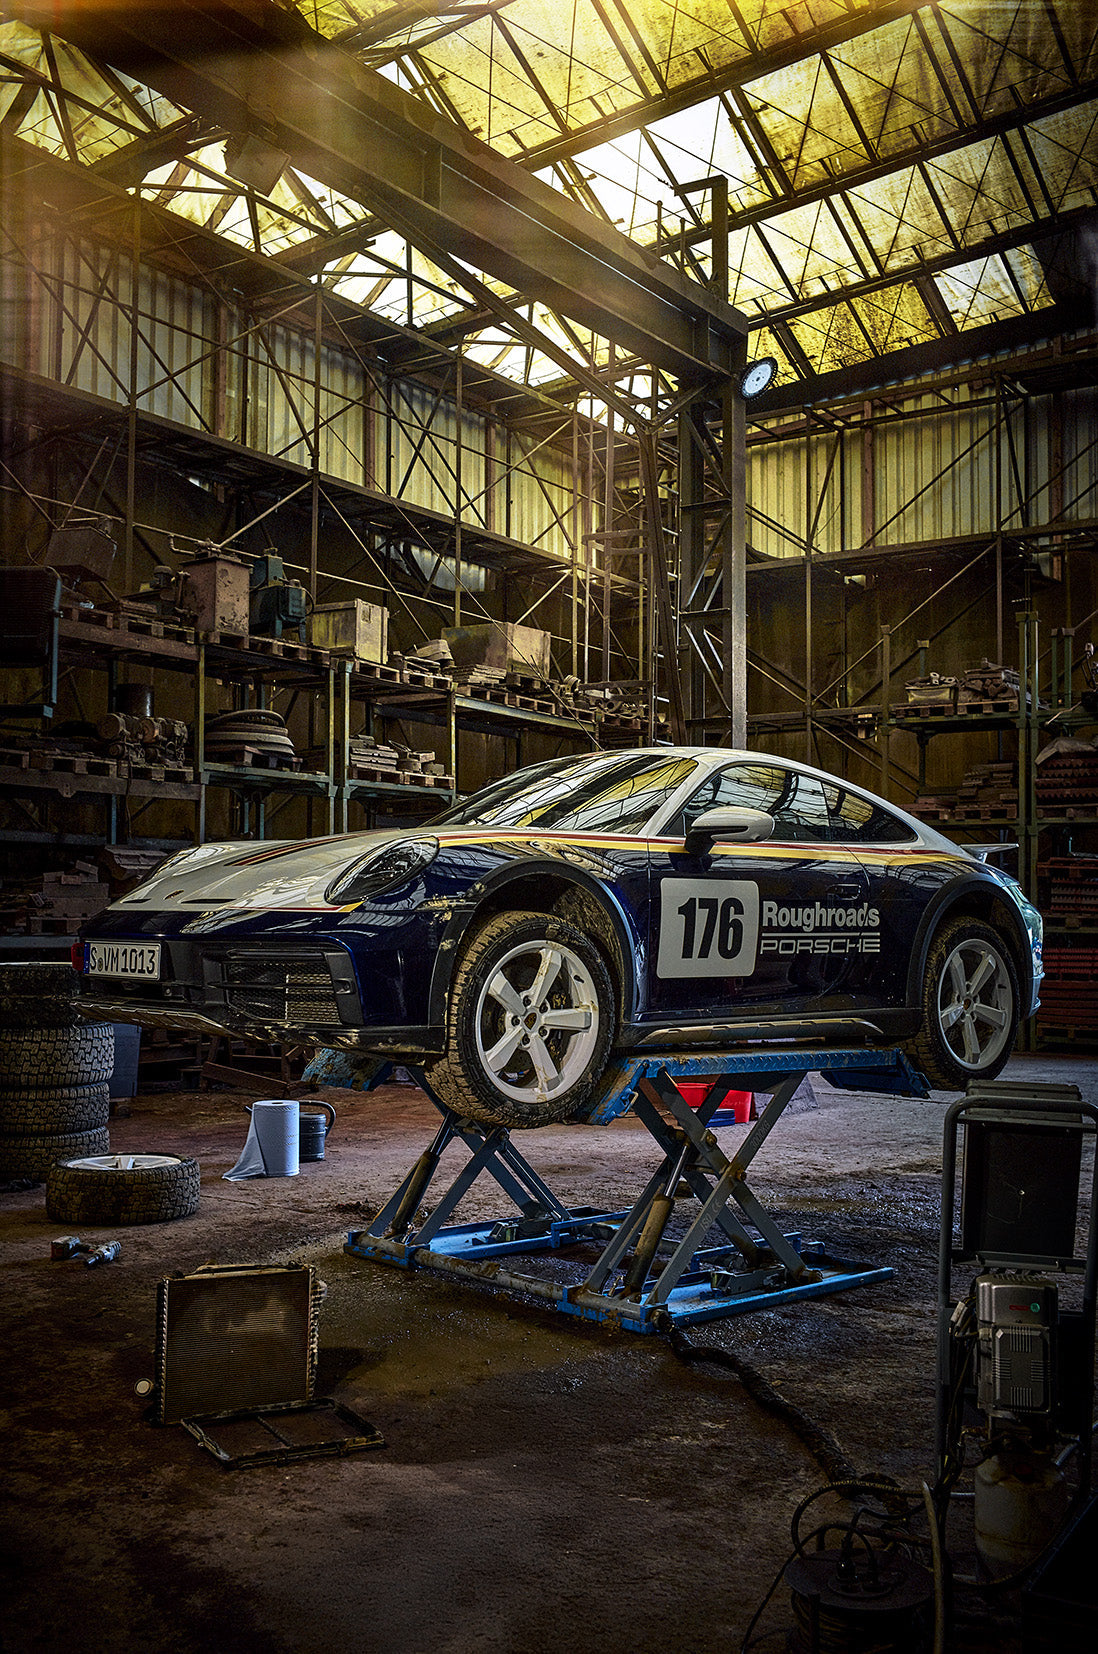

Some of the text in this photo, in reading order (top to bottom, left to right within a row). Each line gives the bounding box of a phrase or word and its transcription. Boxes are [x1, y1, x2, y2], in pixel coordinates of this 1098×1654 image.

[677, 897, 745, 960] 176
[762, 901, 880, 932] Roughroads
[759, 938, 881, 955] PORSCHE
